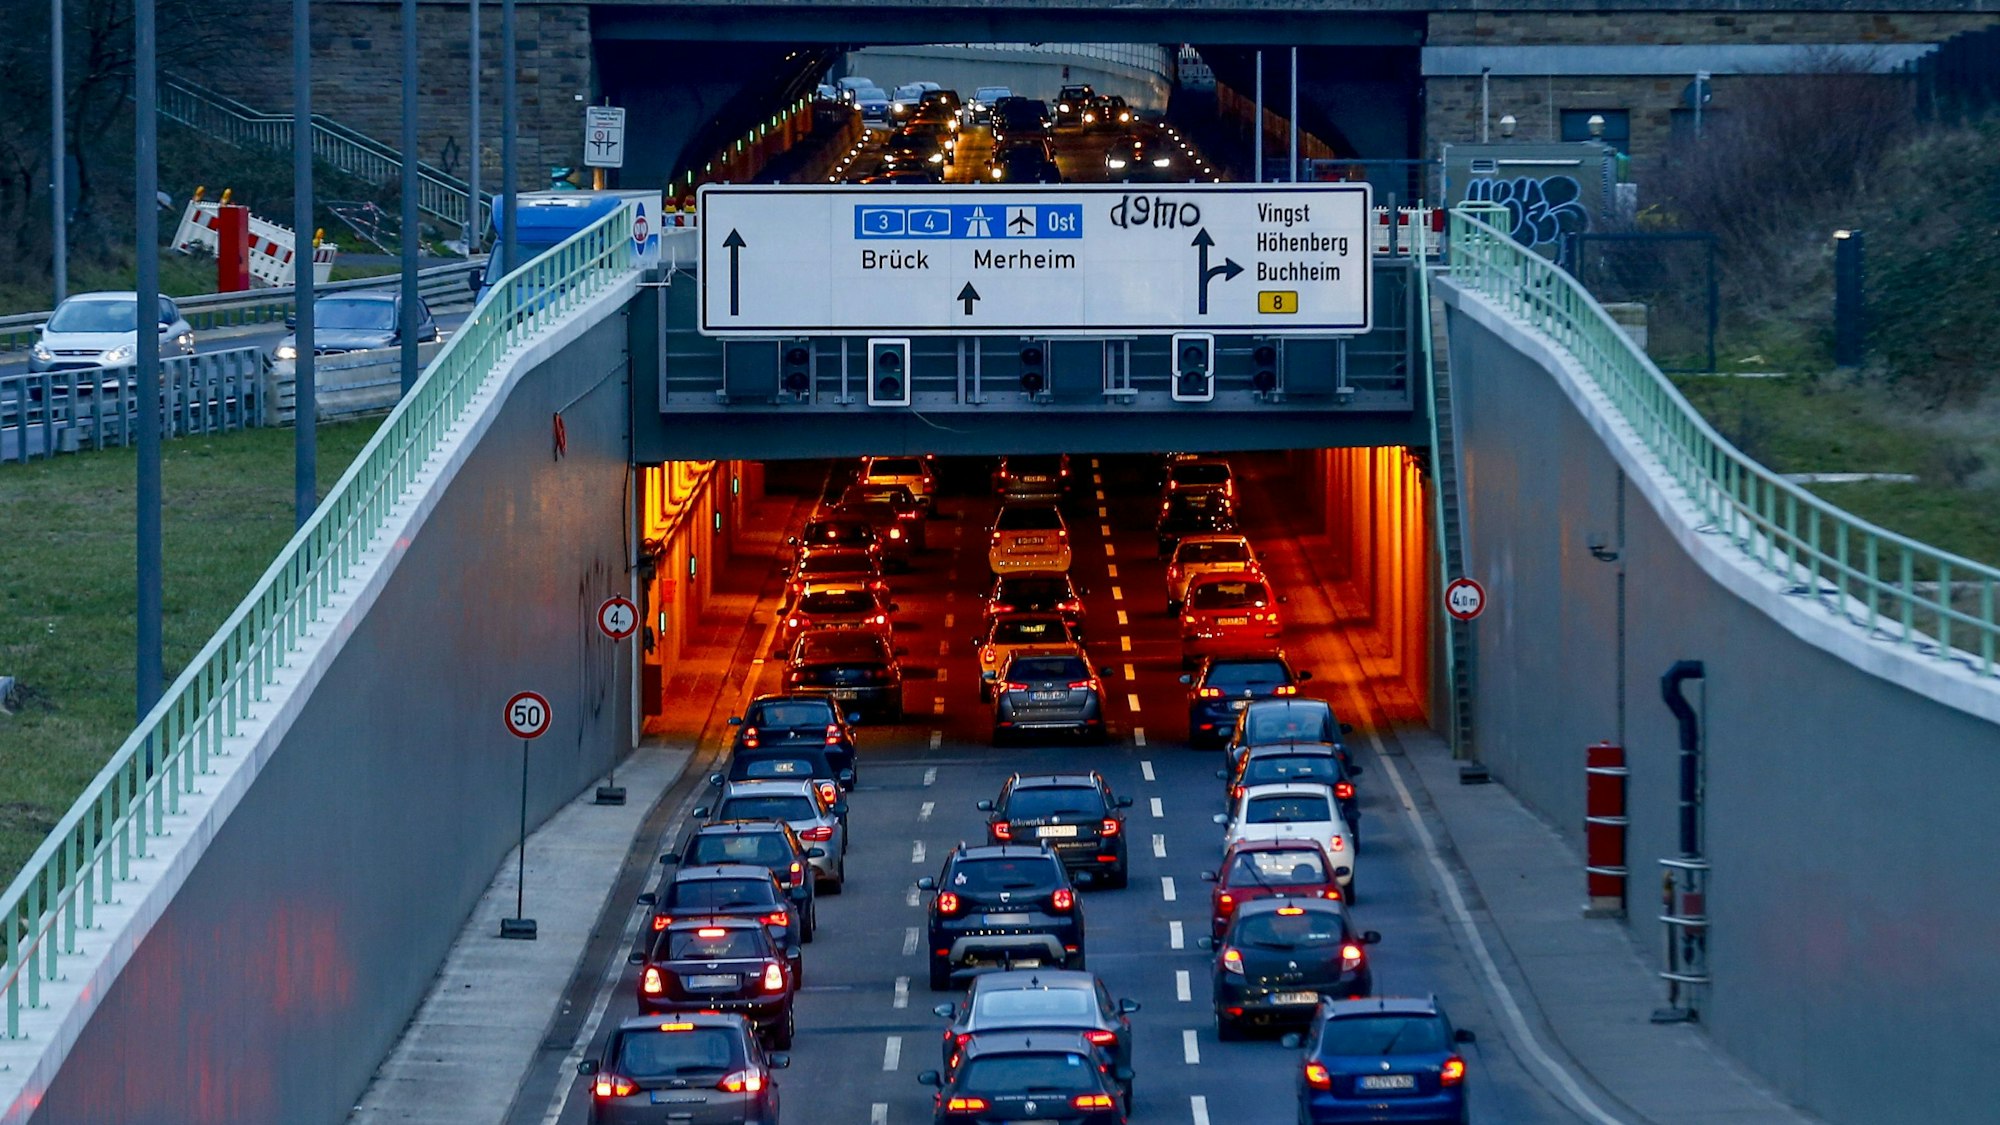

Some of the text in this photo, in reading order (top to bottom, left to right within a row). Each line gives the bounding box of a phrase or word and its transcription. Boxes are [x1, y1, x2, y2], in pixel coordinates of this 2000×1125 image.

[878, 211, 1076, 232] 3 4 Ost
[1257, 203, 1310, 227] Vingst
[1257, 232, 1348, 256] Höhenberg
[862, 249, 1076, 269] Brück Merheim
[1257, 261, 1341, 281] Buchheim
[1273, 295, 1283, 310] 8
[514, 705, 540, 727] 50
